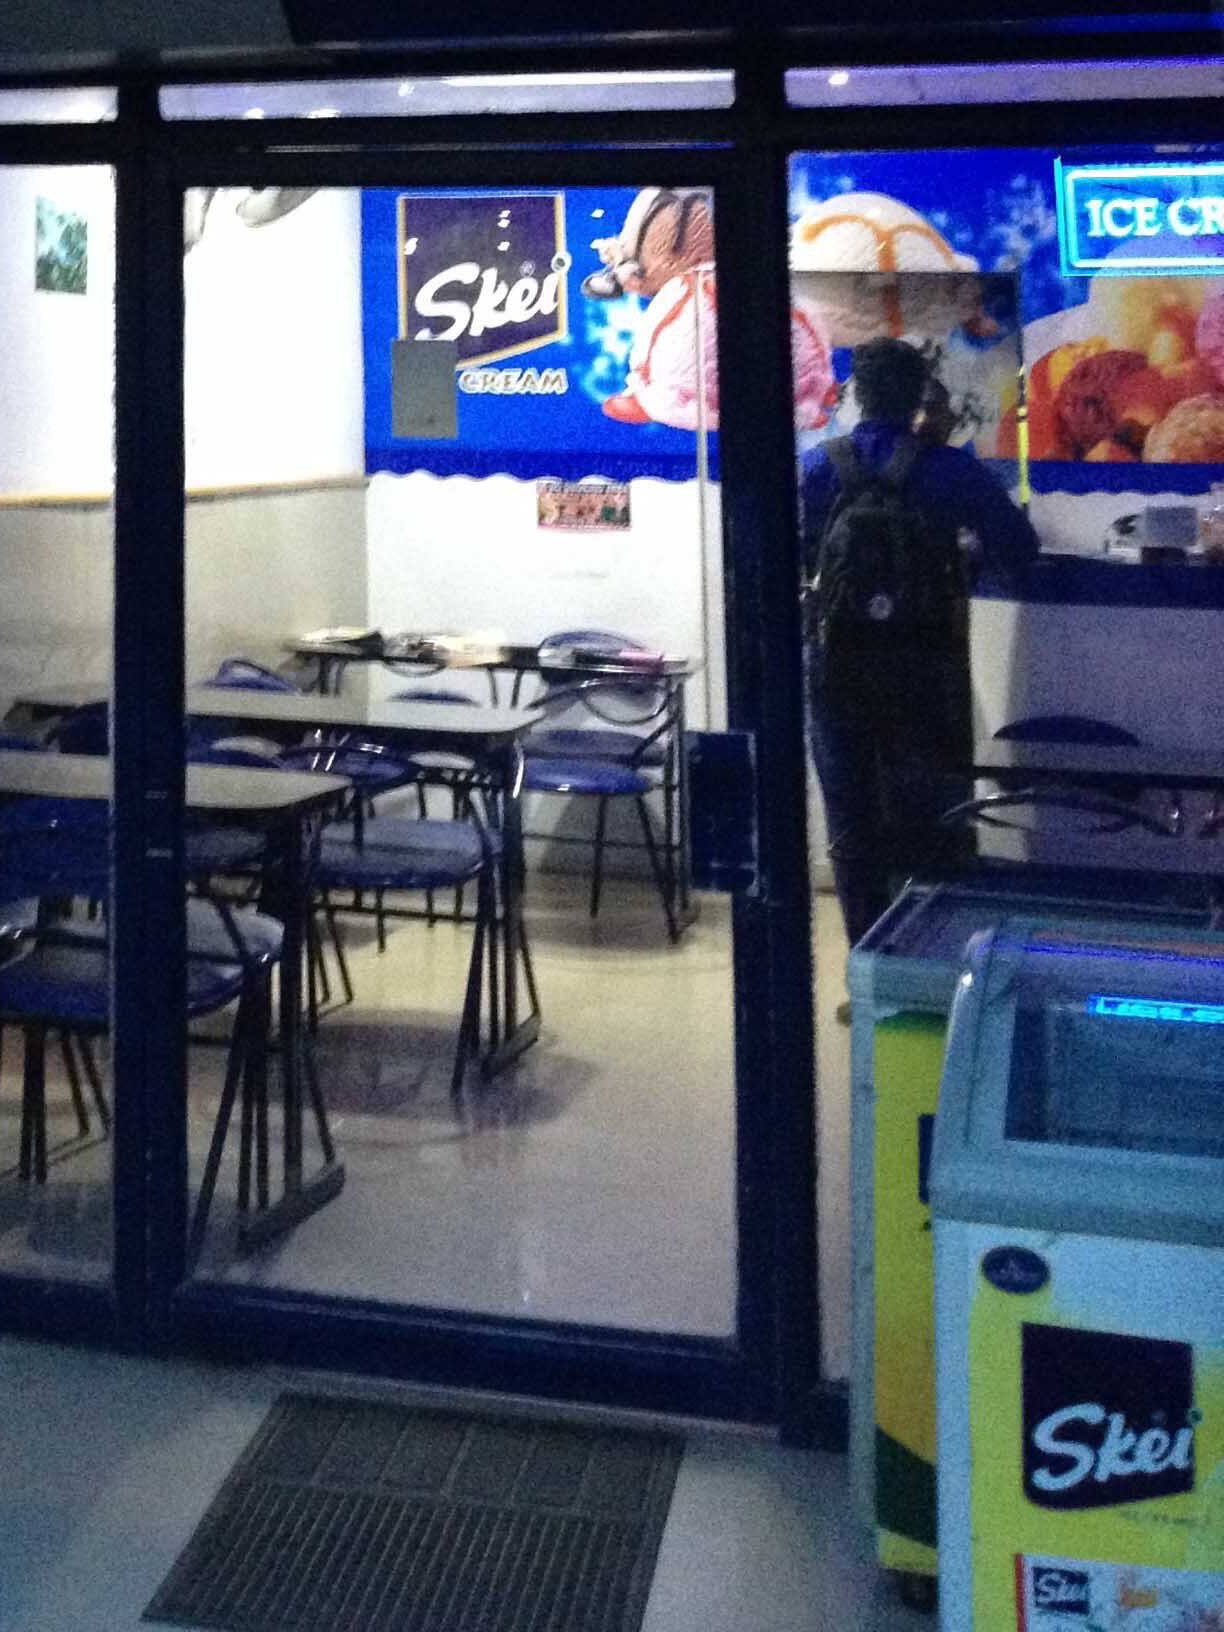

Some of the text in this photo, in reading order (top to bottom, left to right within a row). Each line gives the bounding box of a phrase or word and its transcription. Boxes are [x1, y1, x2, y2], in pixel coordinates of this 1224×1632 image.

[1083, 197, 1164, 238] ICE
[413, 251, 573, 342] Skei
[457, 367, 569, 395] CREAM
[1031, 1401, 1203, 1492] Skei
